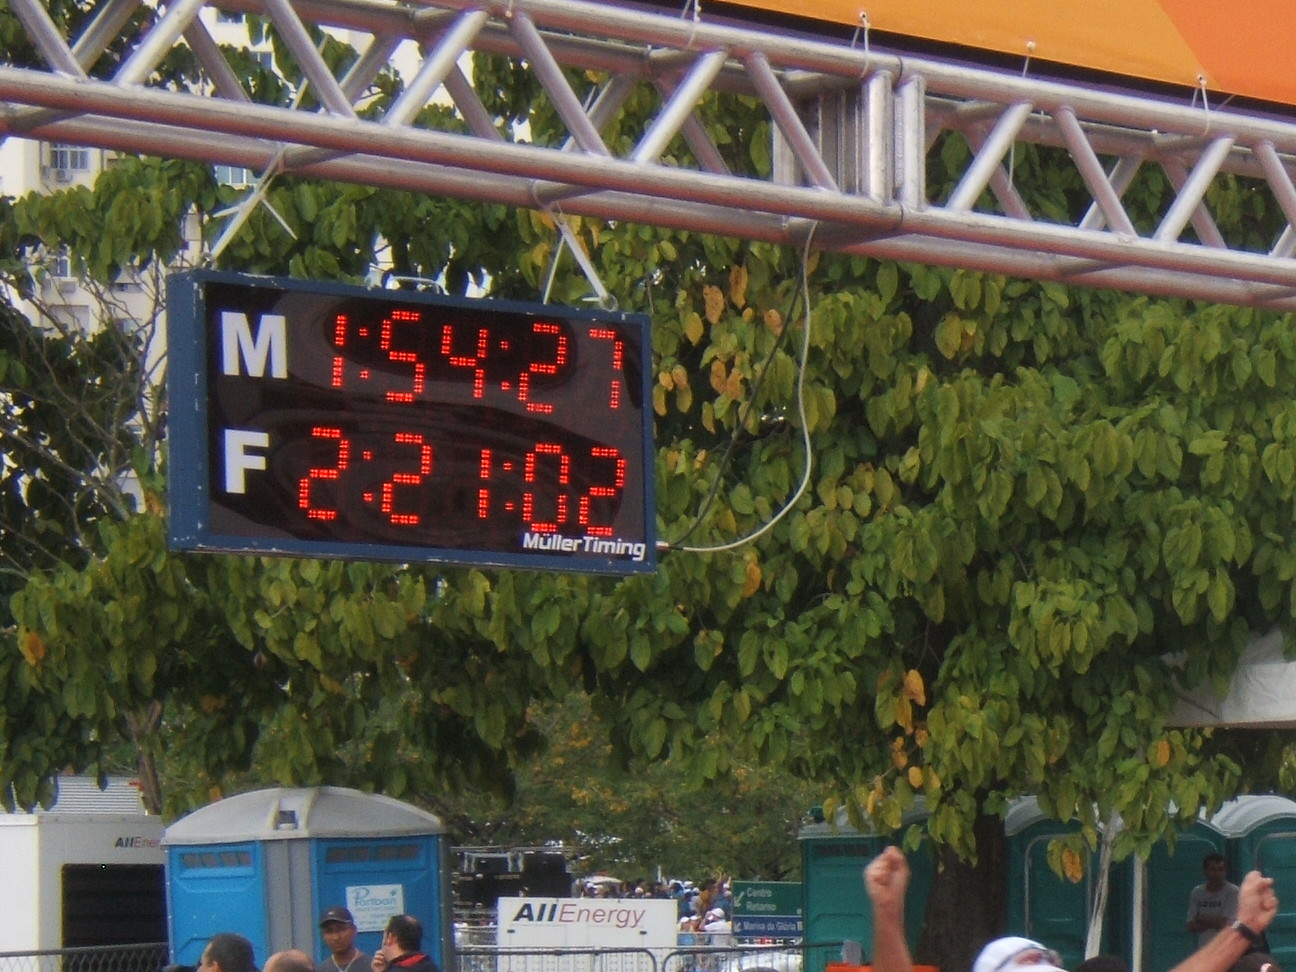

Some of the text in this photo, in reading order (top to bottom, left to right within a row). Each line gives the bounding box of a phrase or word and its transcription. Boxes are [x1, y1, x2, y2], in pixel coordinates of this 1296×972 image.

[220, 309, 625, 415] M 1:54:27
[223, 425, 627, 537] F 2:21:02
